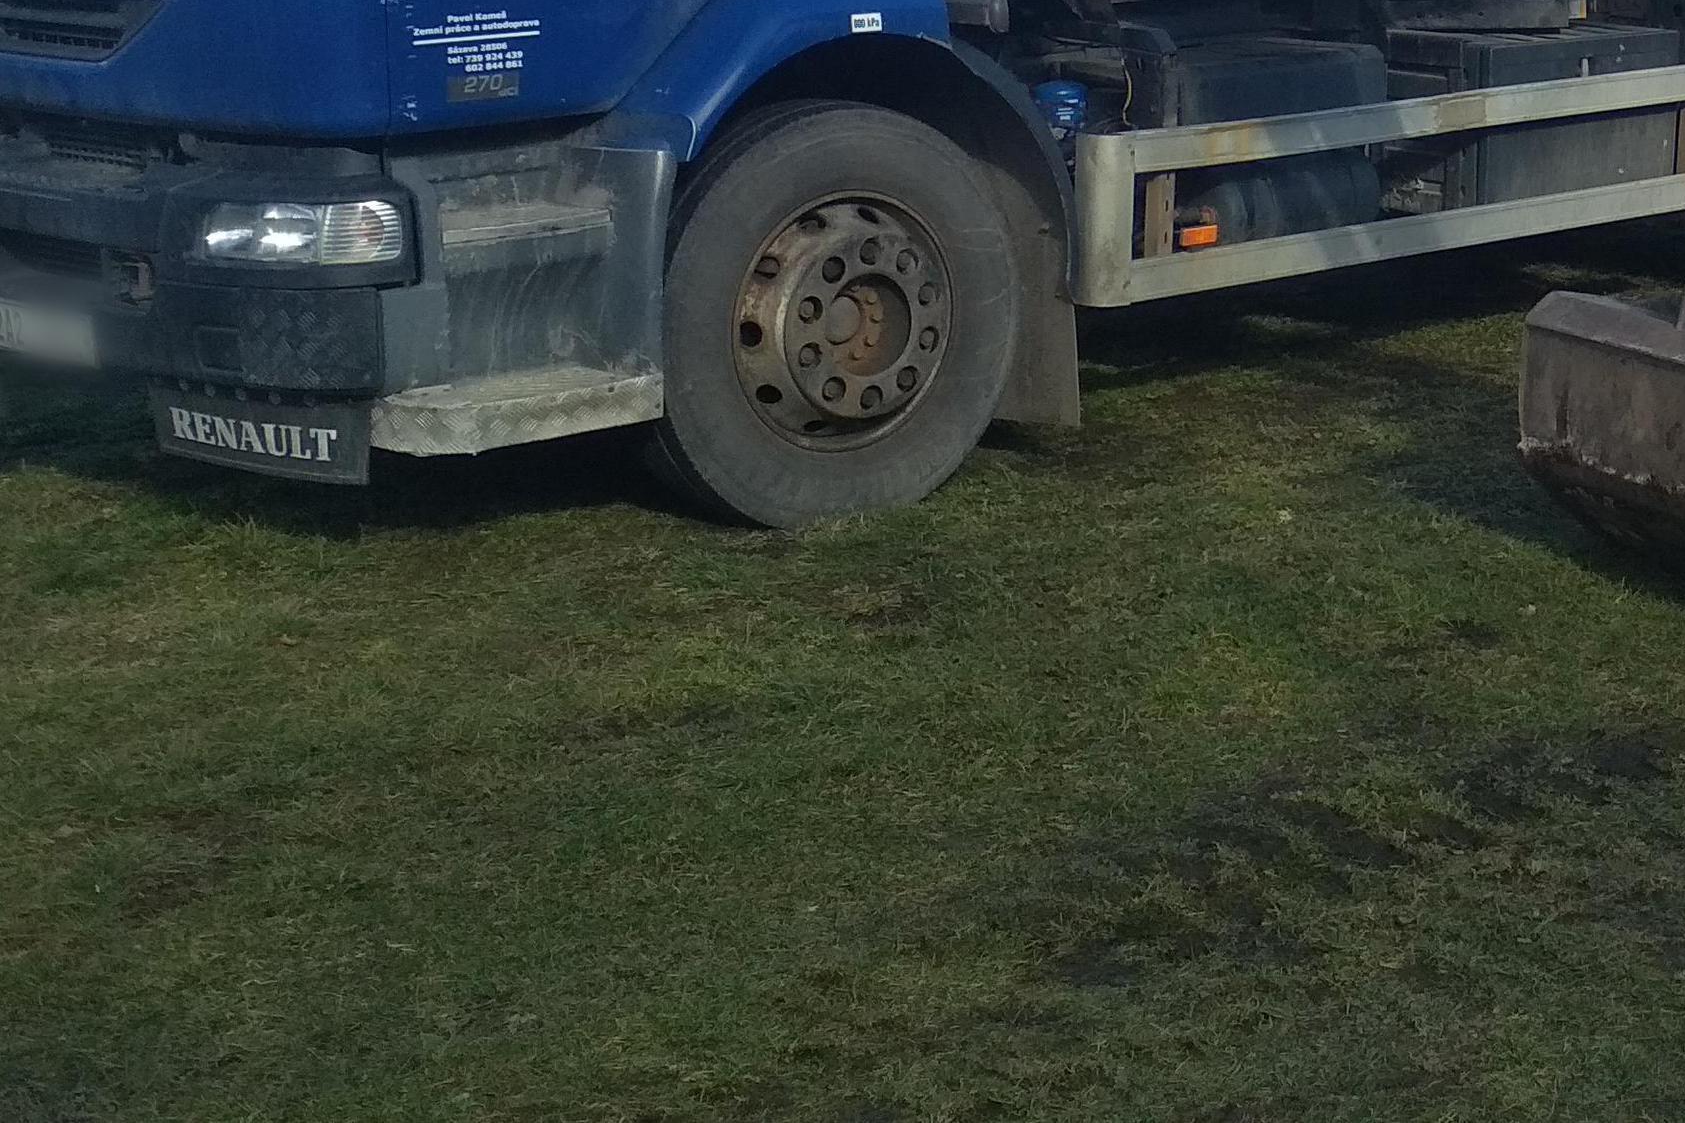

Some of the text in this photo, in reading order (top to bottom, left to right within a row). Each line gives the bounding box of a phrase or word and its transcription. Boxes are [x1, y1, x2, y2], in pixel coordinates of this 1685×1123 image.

[447, 12, 473, 24] Pavel
[413, 26, 444, 37] Zemní
[444, 24, 472, 36] práce
[481, 19, 540, 32] autodoprava
[447, 45, 478, 55] Sázava
[447, 55, 463, 65] tel:
[465, 53, 484, 64] 739
[505, 50, 523, 61] 439
[465, 62, 484, 73] 602
[463, 73, 504, 94] 270
[169, 406, 337, 462] RENAULT
